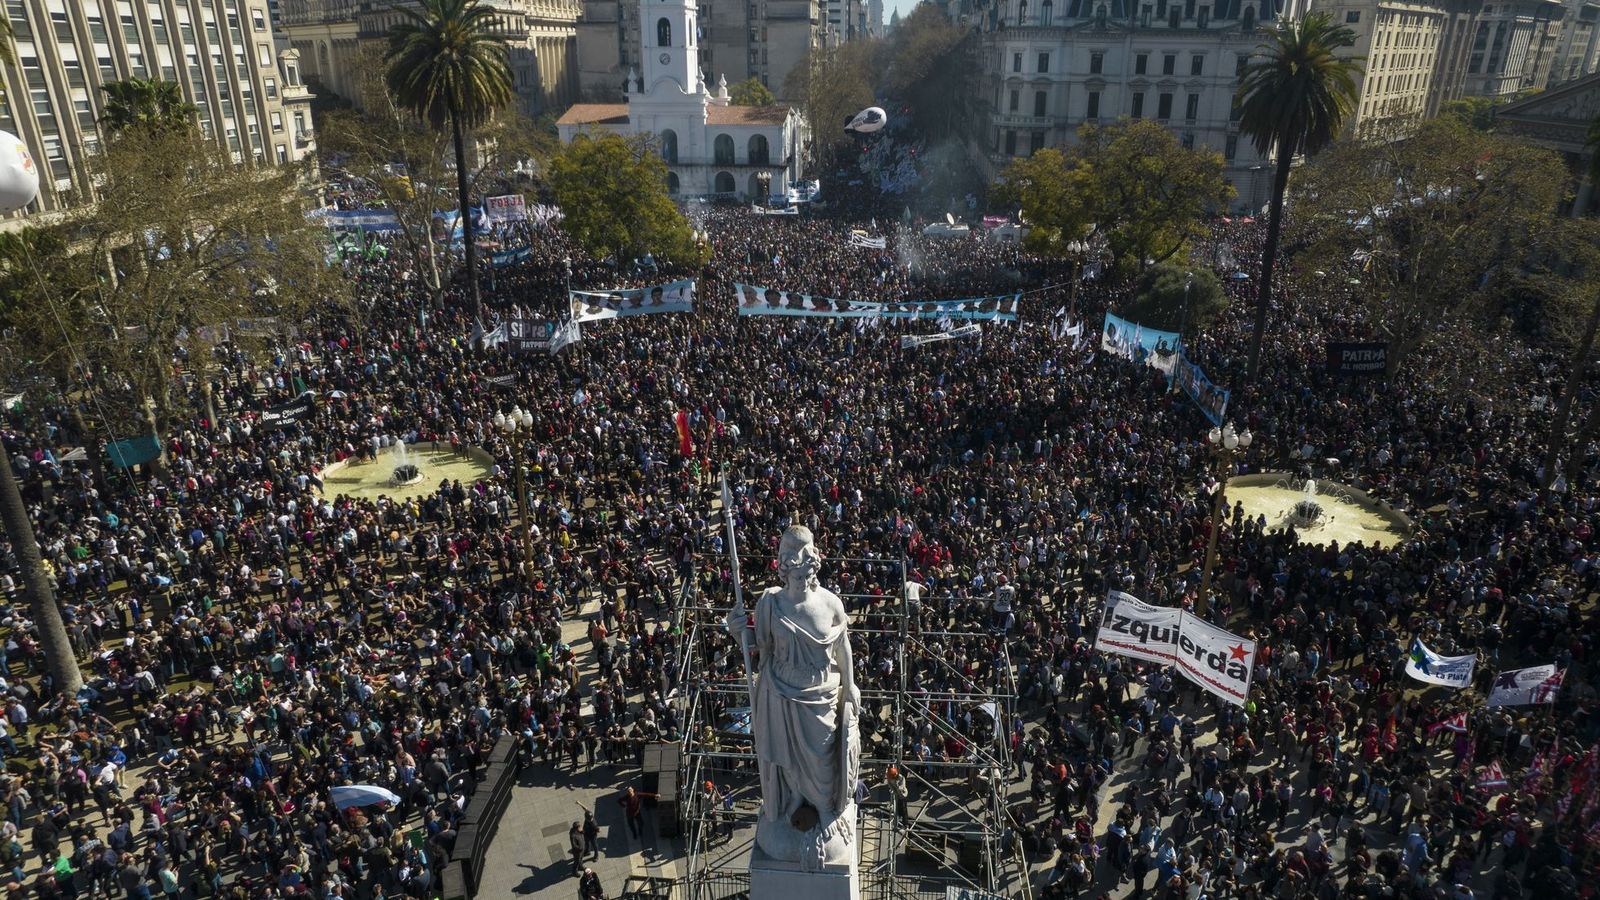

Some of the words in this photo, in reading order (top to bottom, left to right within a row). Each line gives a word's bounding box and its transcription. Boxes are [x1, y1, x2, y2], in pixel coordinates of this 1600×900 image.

[490, 196, 523, 209] FORJA
[1353, 362, 1386, 371] HOMBRO
[999, 592, 1011, 602] 20
[1103, 607, 1249, 683] Izquierda
[1435, 671, 1445, 680] La
